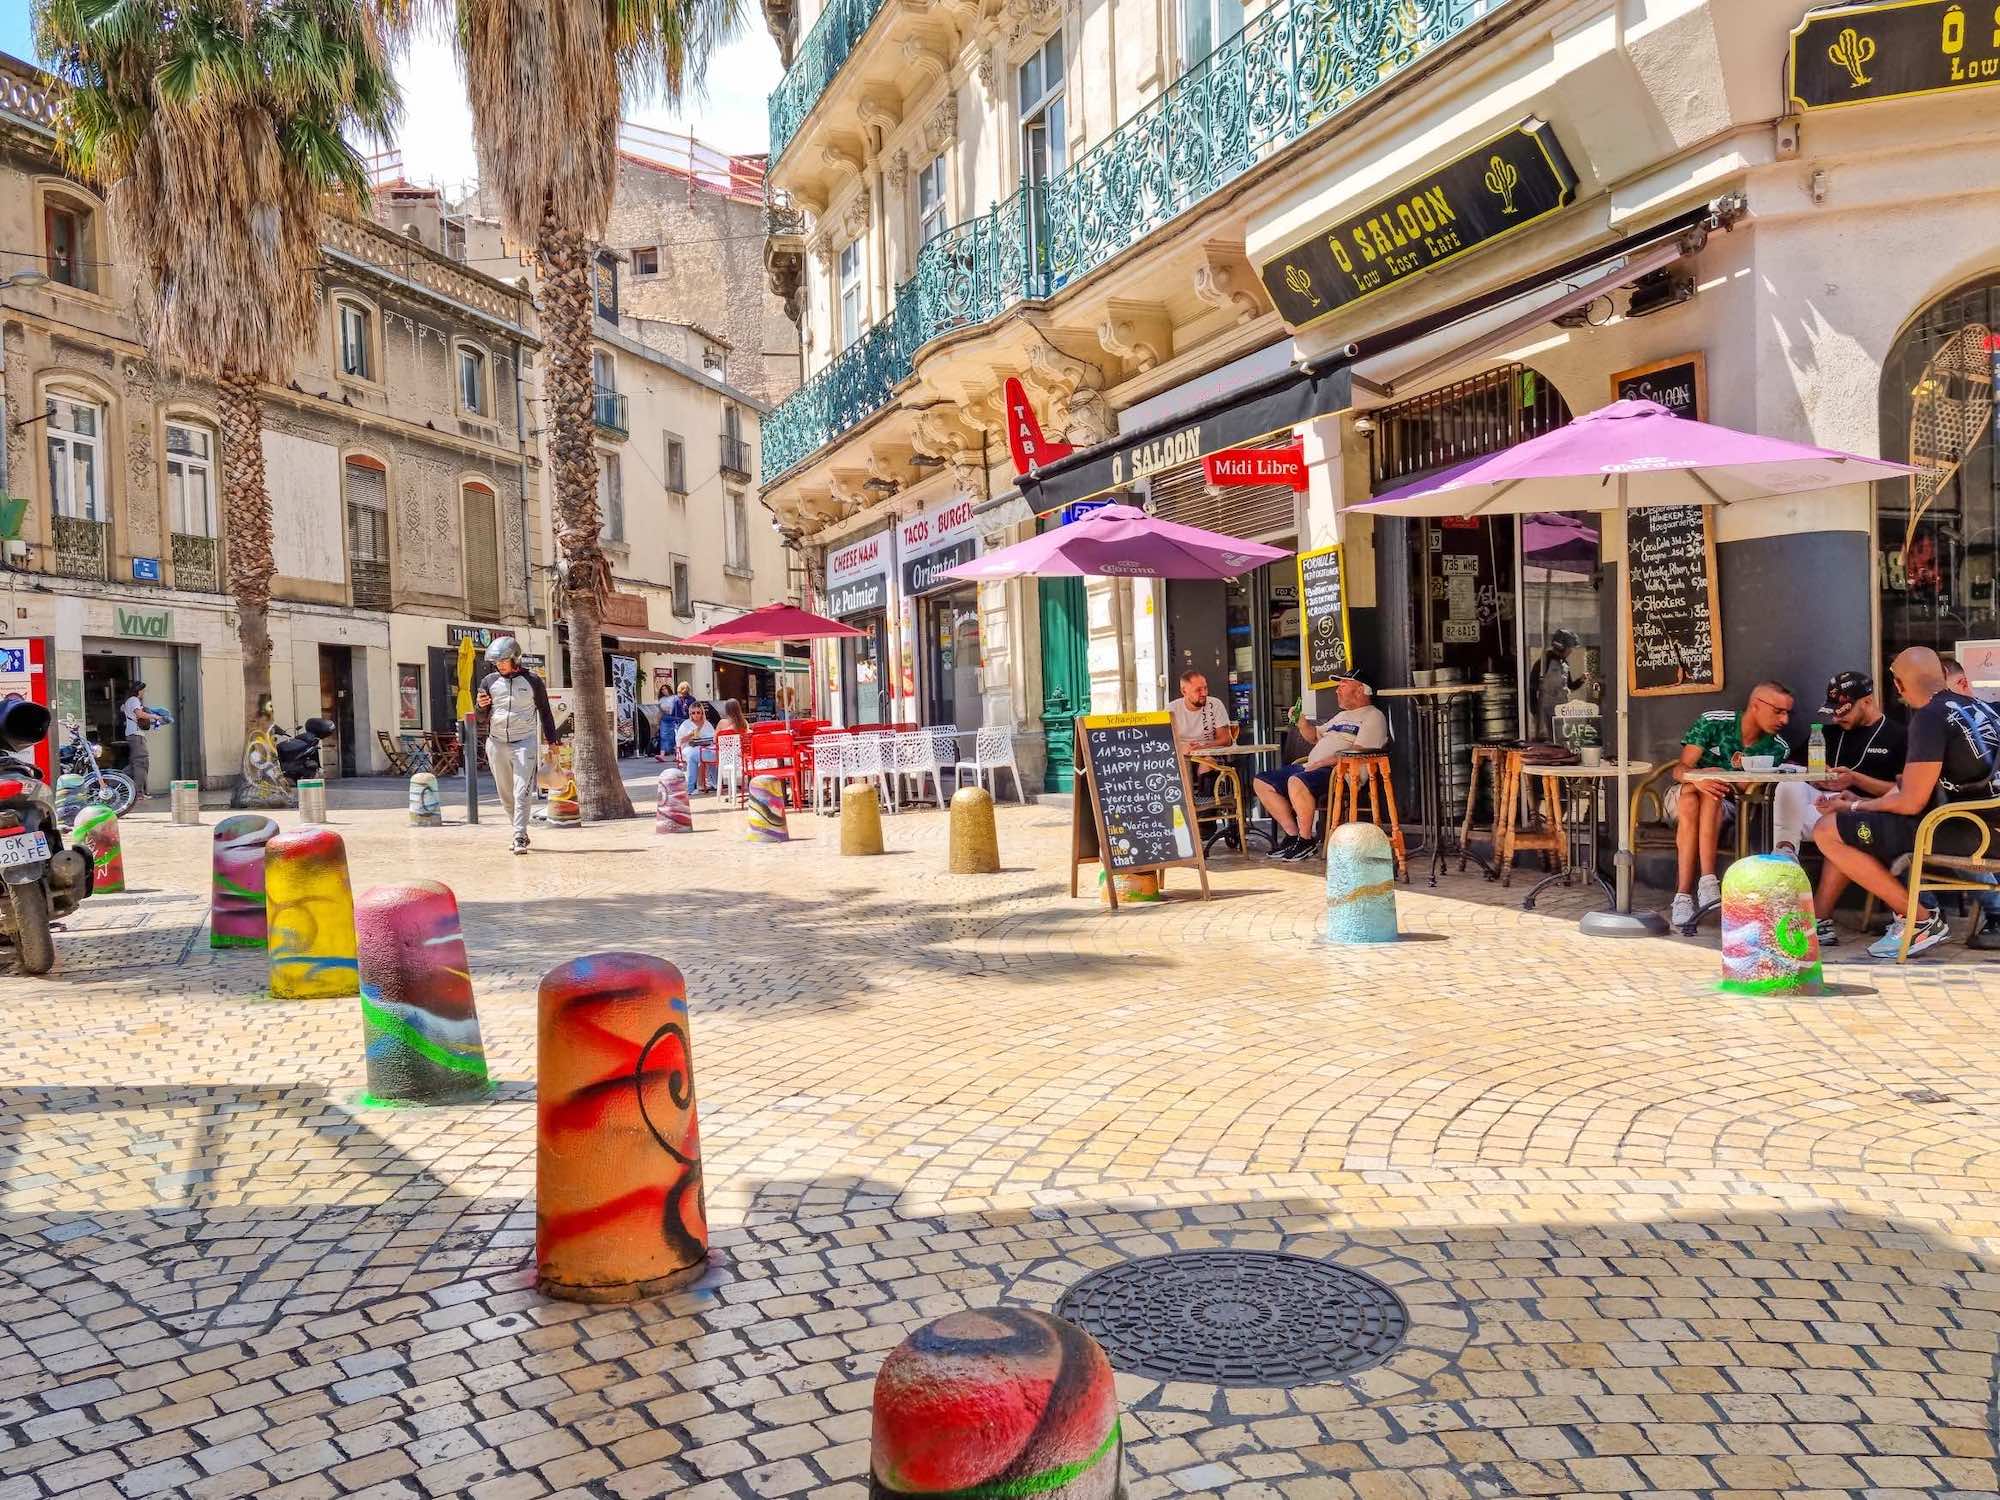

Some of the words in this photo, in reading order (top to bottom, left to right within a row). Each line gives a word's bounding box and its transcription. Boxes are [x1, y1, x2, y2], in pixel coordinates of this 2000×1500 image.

[1942, 5, 1966, 55] Ô
[1328, 233, 1353, 273] Ô
[1352, 185, 1456, 263] SALOON
[1112, 450, 1123, 485] Ô
[1131, 427, 1202, 475] SALOON
[1215, 459, 1253, 476] Midi
[1257, 460, 1299, 476] Libre
[903, 521, 929, 547] TACOS
[833, 549, 858, 573] CHEESE
[858, 540, 879, 565] NAAN
[913, 548, 959, 590] Oriental
[831, 594, 840, 615] Le
[842, 582, 879, 611] Palmier
[118, 607, 169, 638] Vival
[1143, 757, 1176, 771] HOUR
[1867, 747, 1889, 755] HUGO
[1107, 825, 1125, 835] like
[1109, 835, 1118, 845] it
[1113, 856, 1135, 866] that
